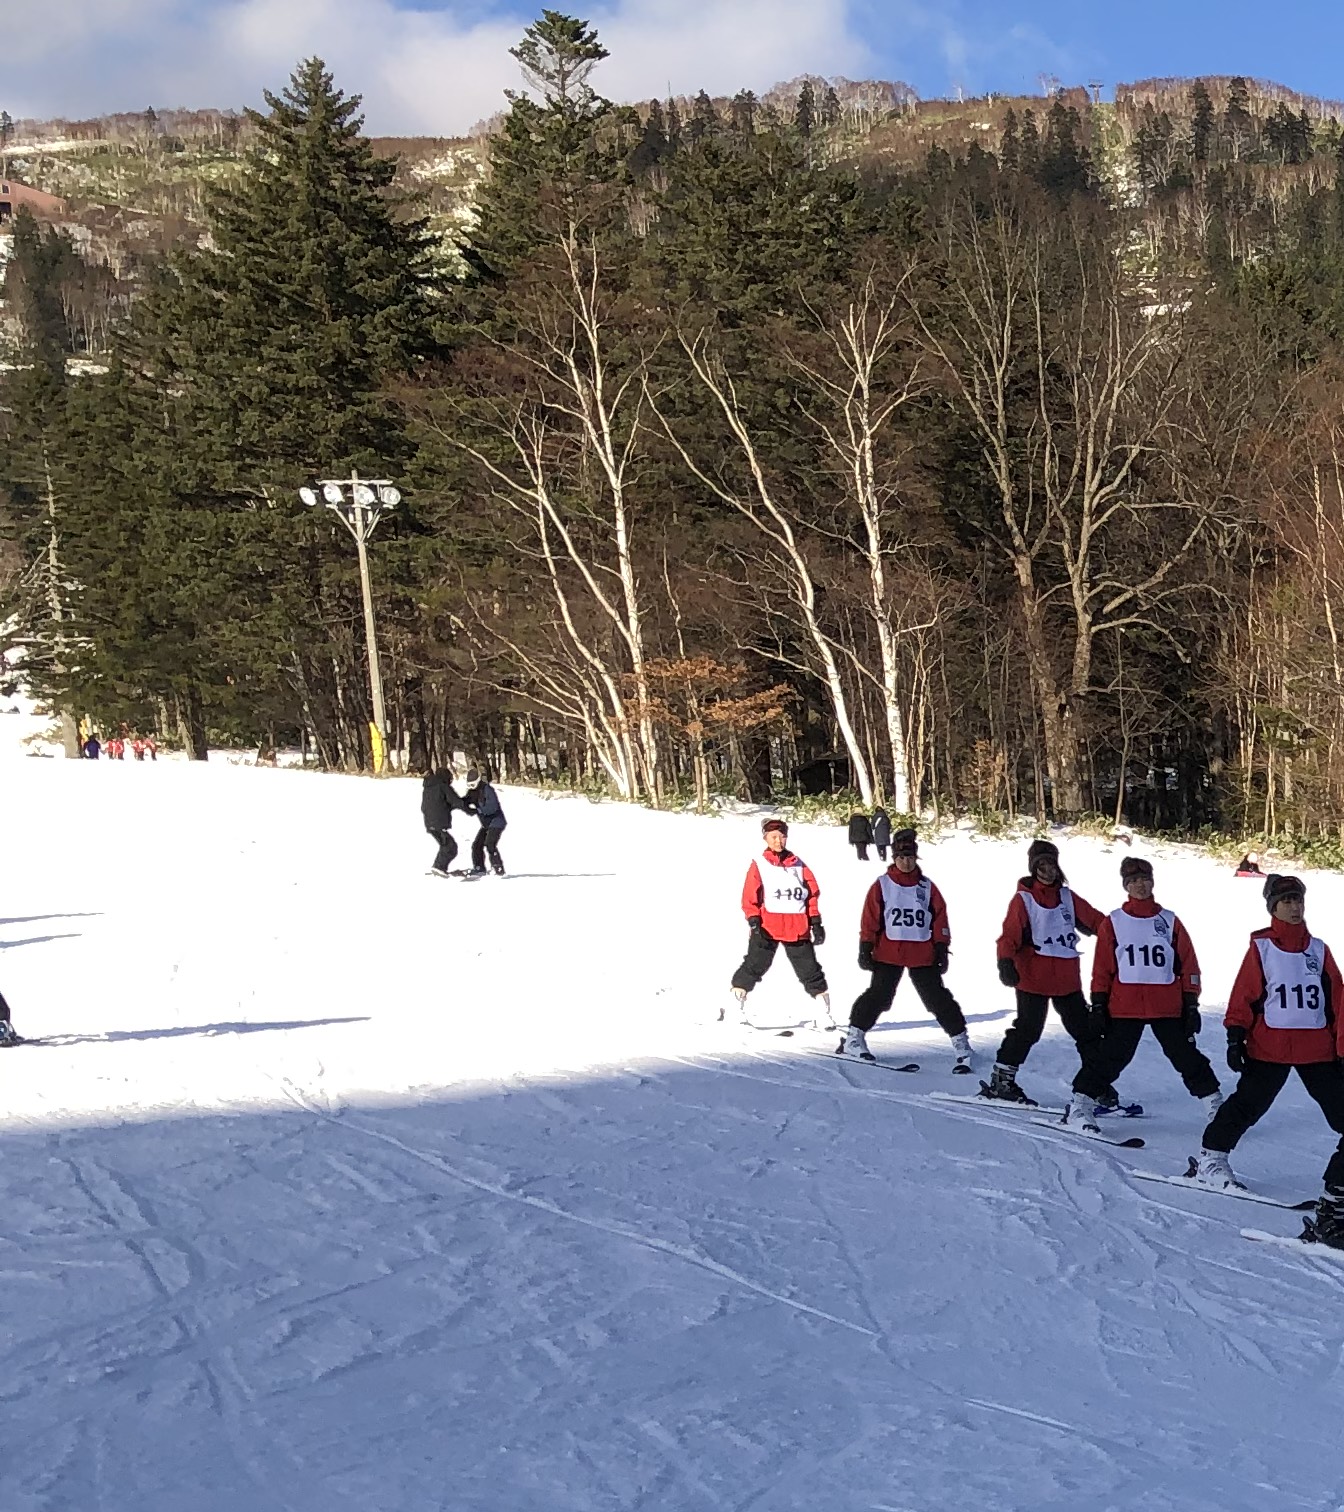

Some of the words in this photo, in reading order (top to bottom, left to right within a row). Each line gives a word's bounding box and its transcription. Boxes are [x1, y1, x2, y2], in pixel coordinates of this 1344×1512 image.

[891, 907, 926, 928] 259
[1124, 944, 1166, 968] 116
[1275, 983, 1320, 1010] 113
